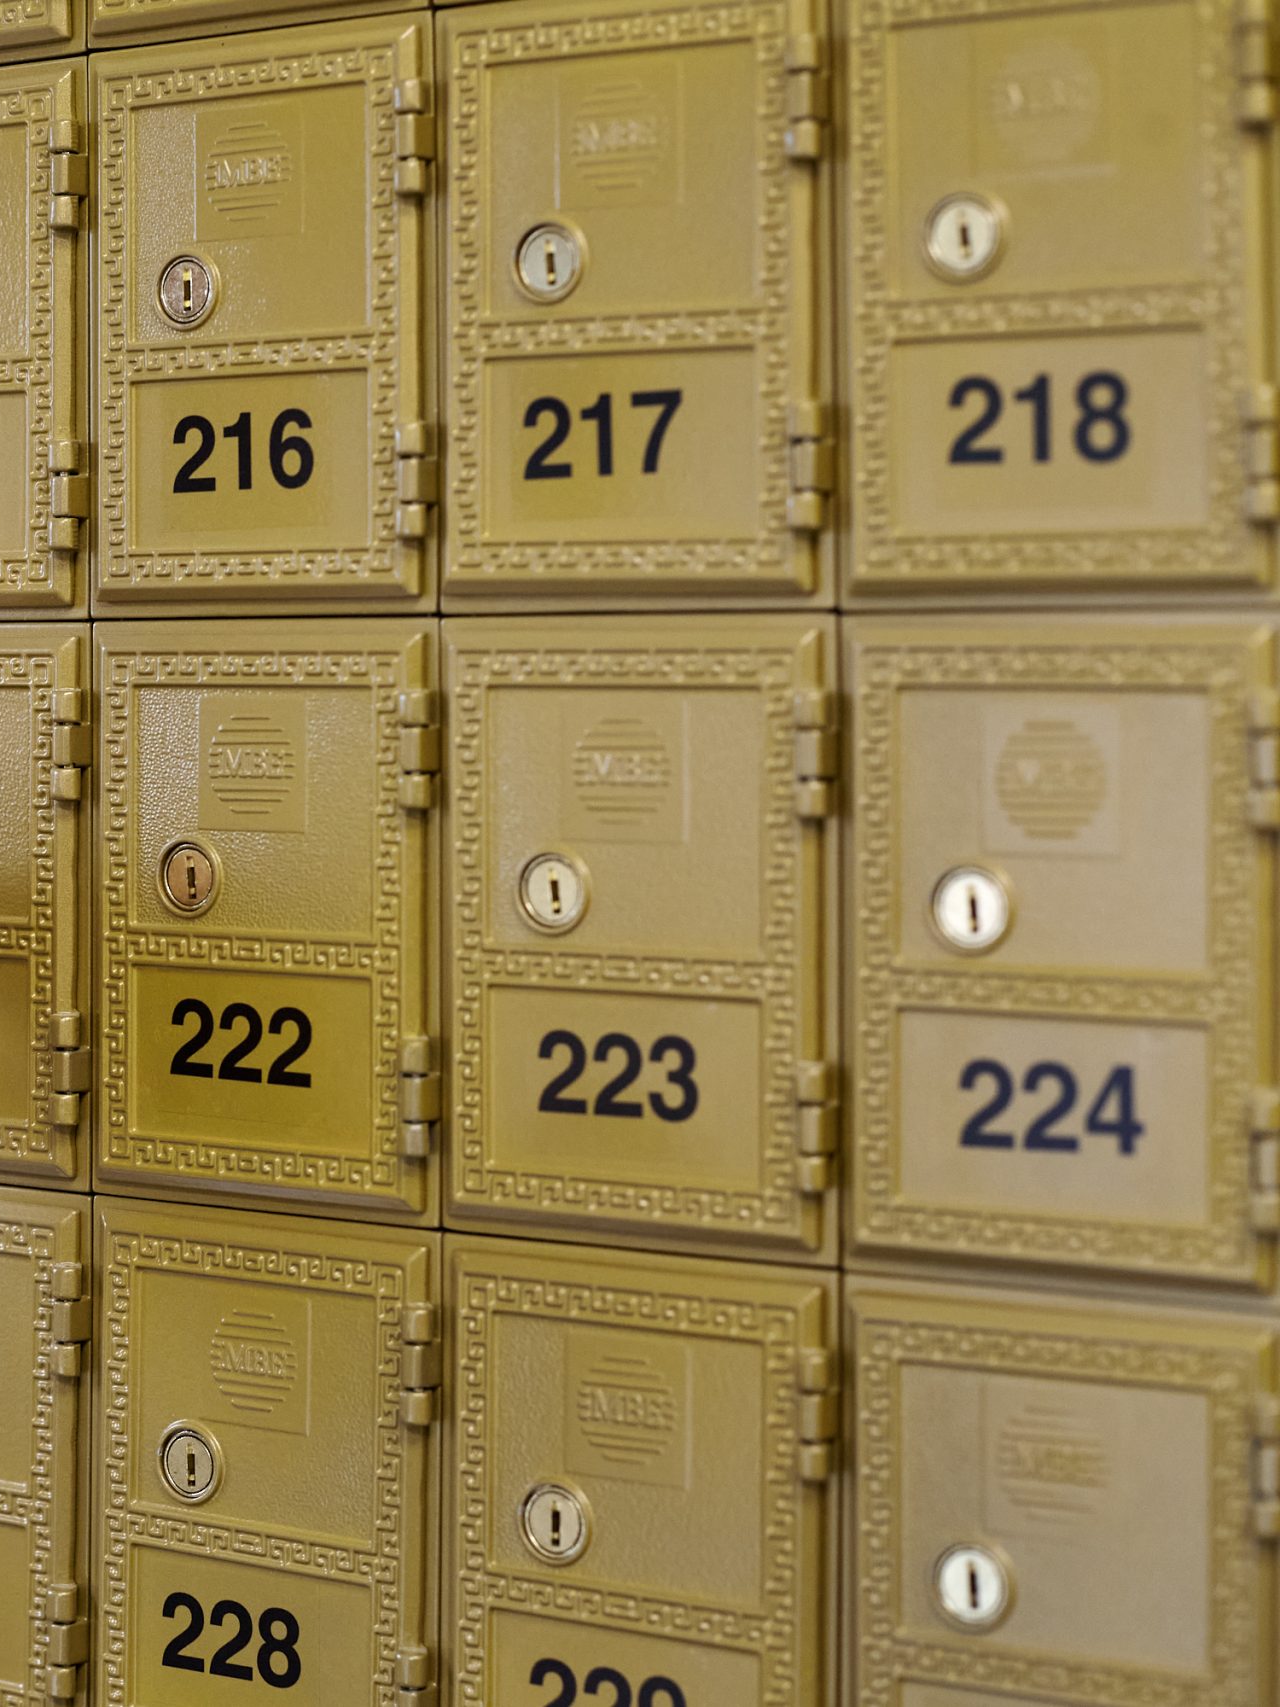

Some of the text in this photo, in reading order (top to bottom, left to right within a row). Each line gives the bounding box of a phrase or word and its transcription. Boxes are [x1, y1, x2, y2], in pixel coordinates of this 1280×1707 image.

[214, 156, 282, 187] MBE
[173, 409, 313, 493] 216
[524, 390, 682, 480] 217
[948, 371, 1131, 465] 218
[221, 749, 284, 777] MBE
[170, 999, 311, 1088] 222
[539, 1030, 698, 1122] 223
[959, 1058, 1145, 1157] 224
[223, 1342, 287, 1376] MBE
[162, 1592, 301, 1688] 228
